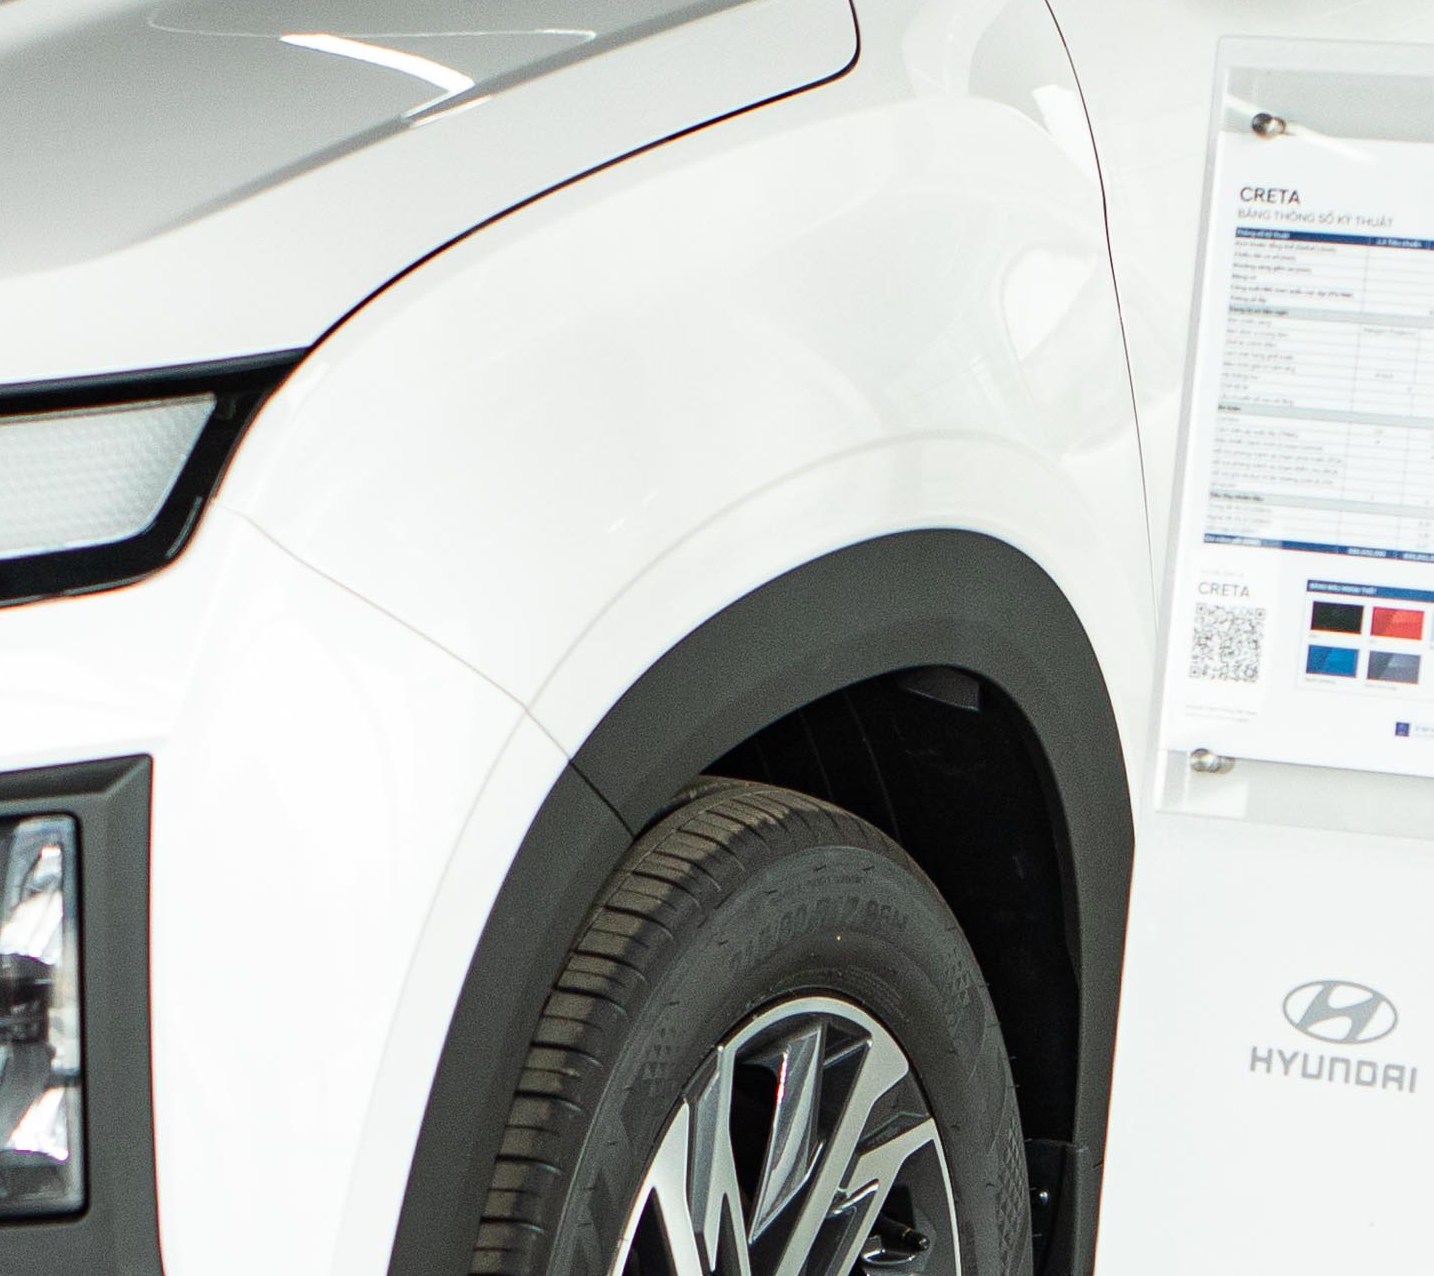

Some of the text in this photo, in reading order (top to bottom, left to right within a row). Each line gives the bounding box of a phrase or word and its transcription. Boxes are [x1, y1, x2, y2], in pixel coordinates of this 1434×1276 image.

[1239, 186, 1301, 205] CRETA
[1197, 581, 1251, 598] CRETA
[1249, 1045, 1418, 1093] HYUNDAI
